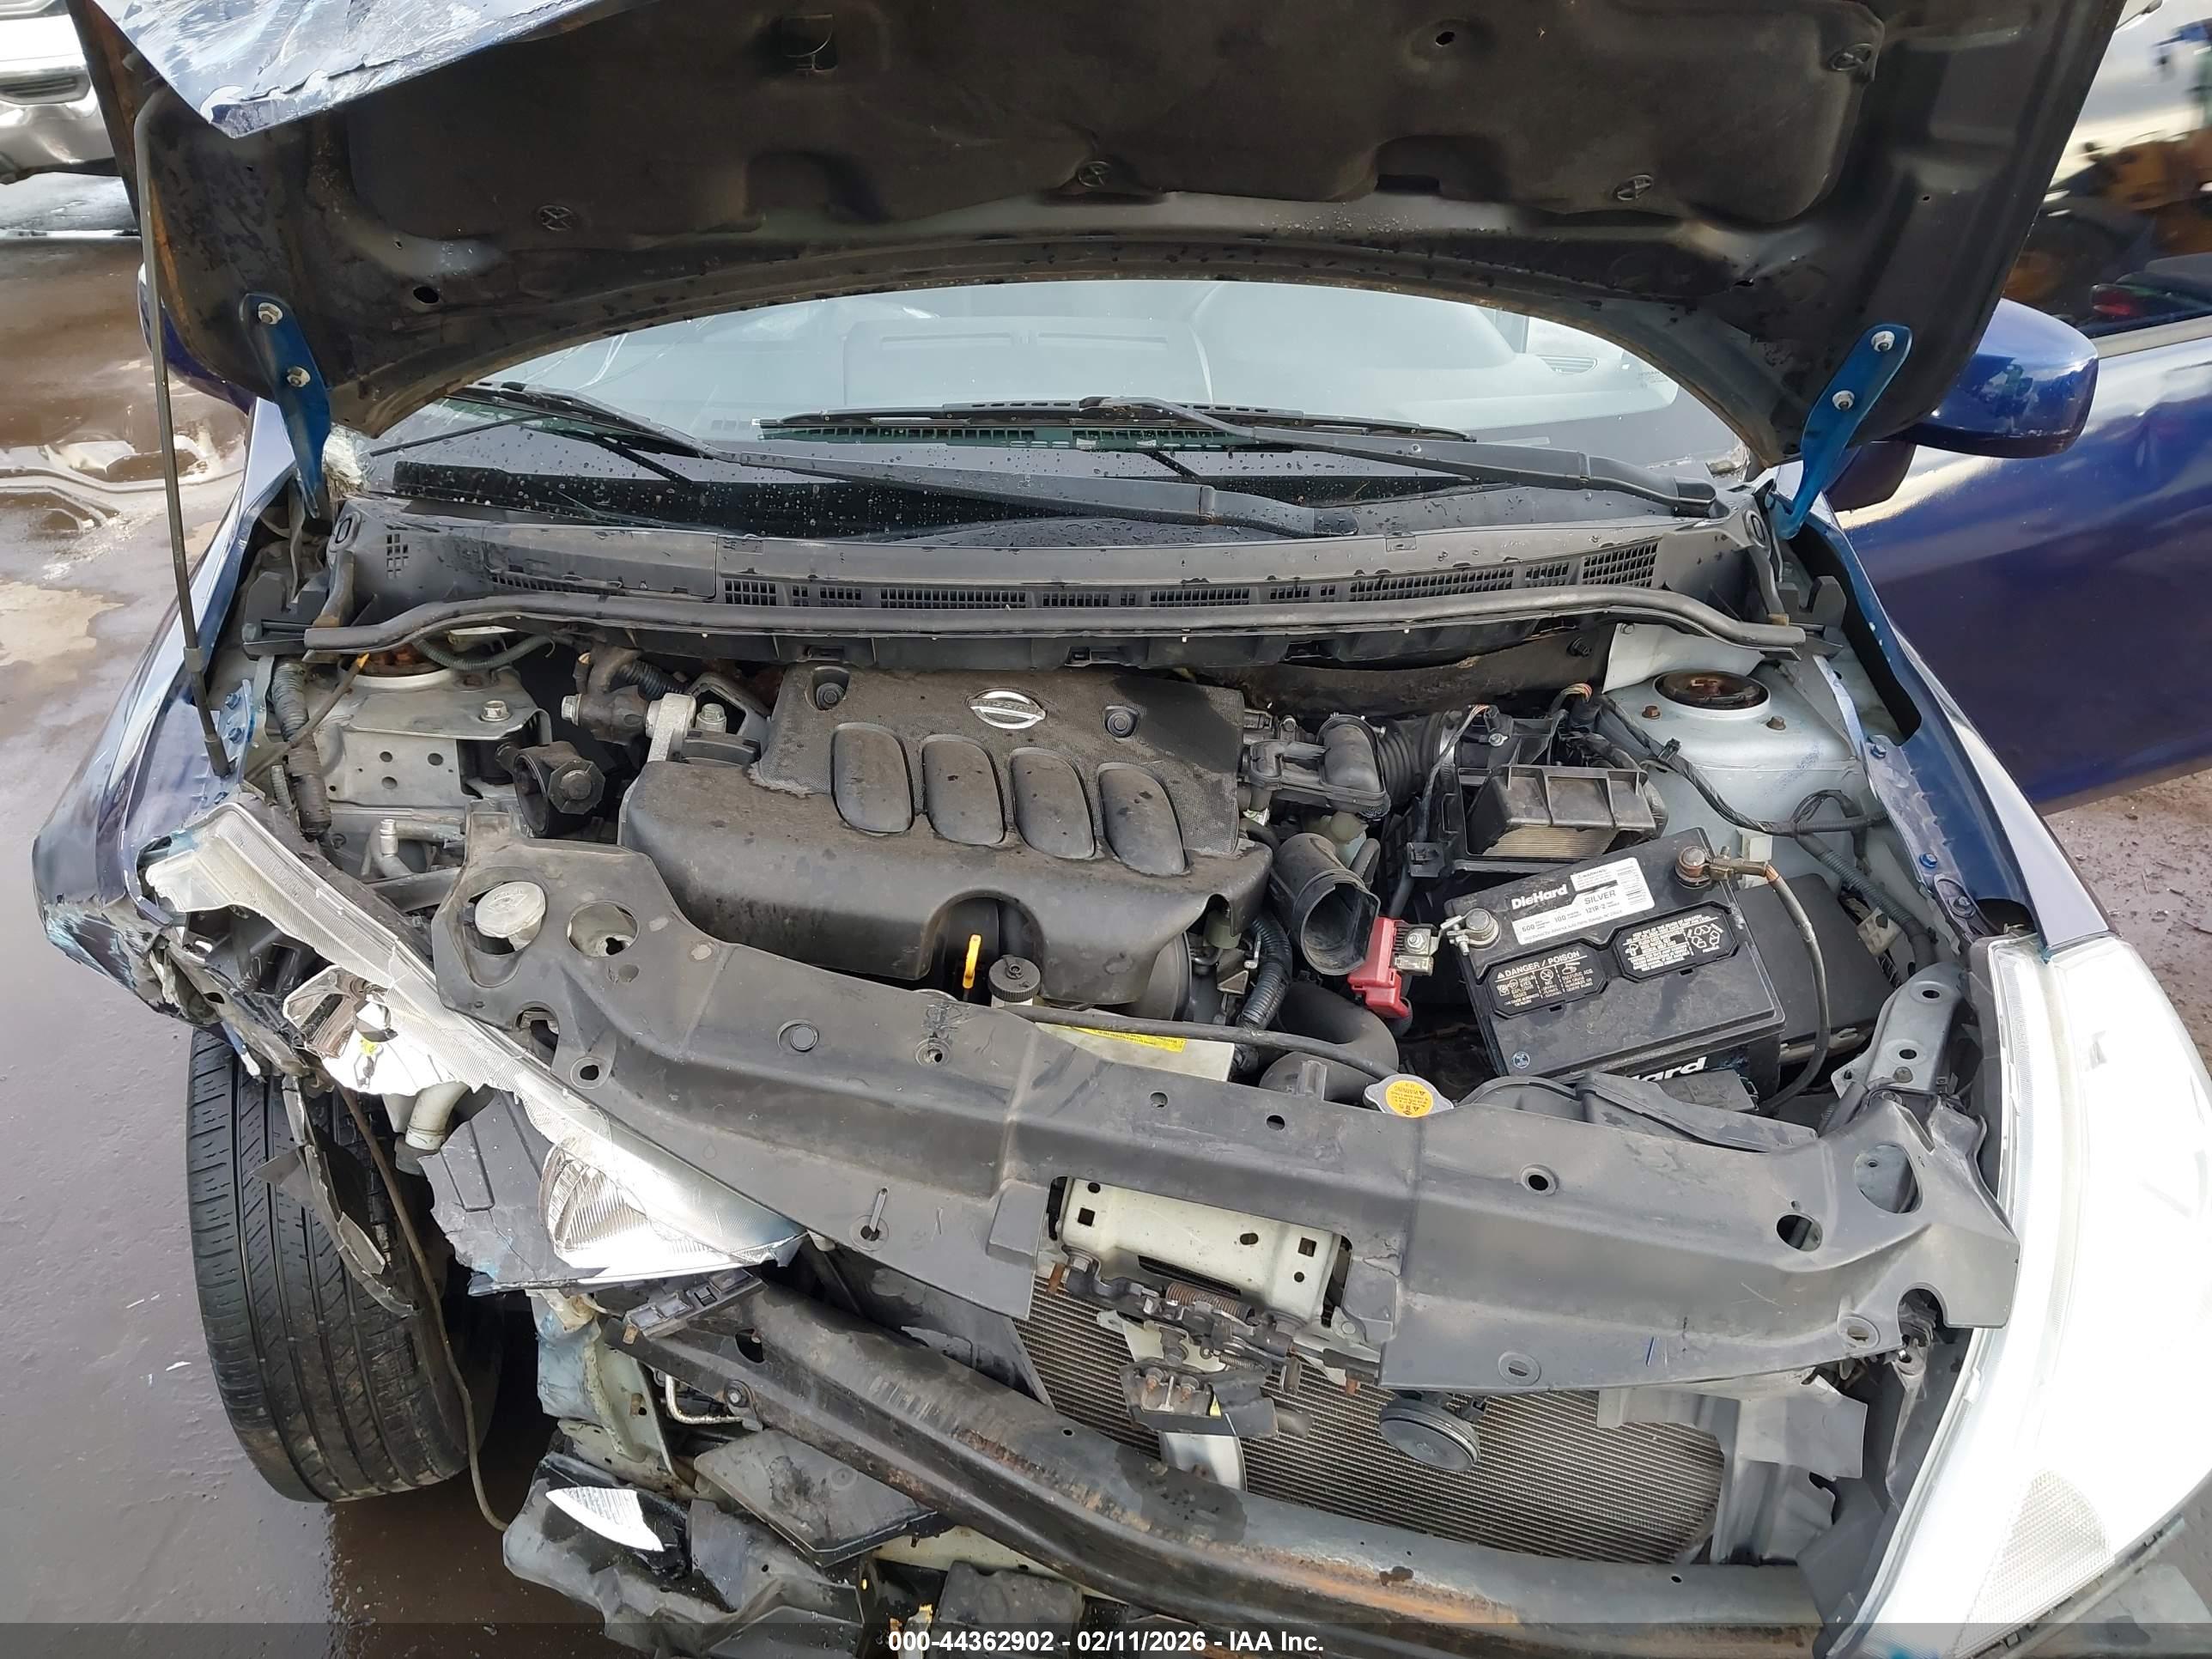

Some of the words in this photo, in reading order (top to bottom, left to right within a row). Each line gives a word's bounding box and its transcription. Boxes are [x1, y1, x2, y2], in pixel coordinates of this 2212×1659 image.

[1511, 884, 1568, 910] DieHard
[1584, 890, 1616, 905] SILVER
[1504, 962, 1540, 976] DANGER
[1547, 951, 1580, 964] POISON
[1632, 1056, 1707, 1082] ard
